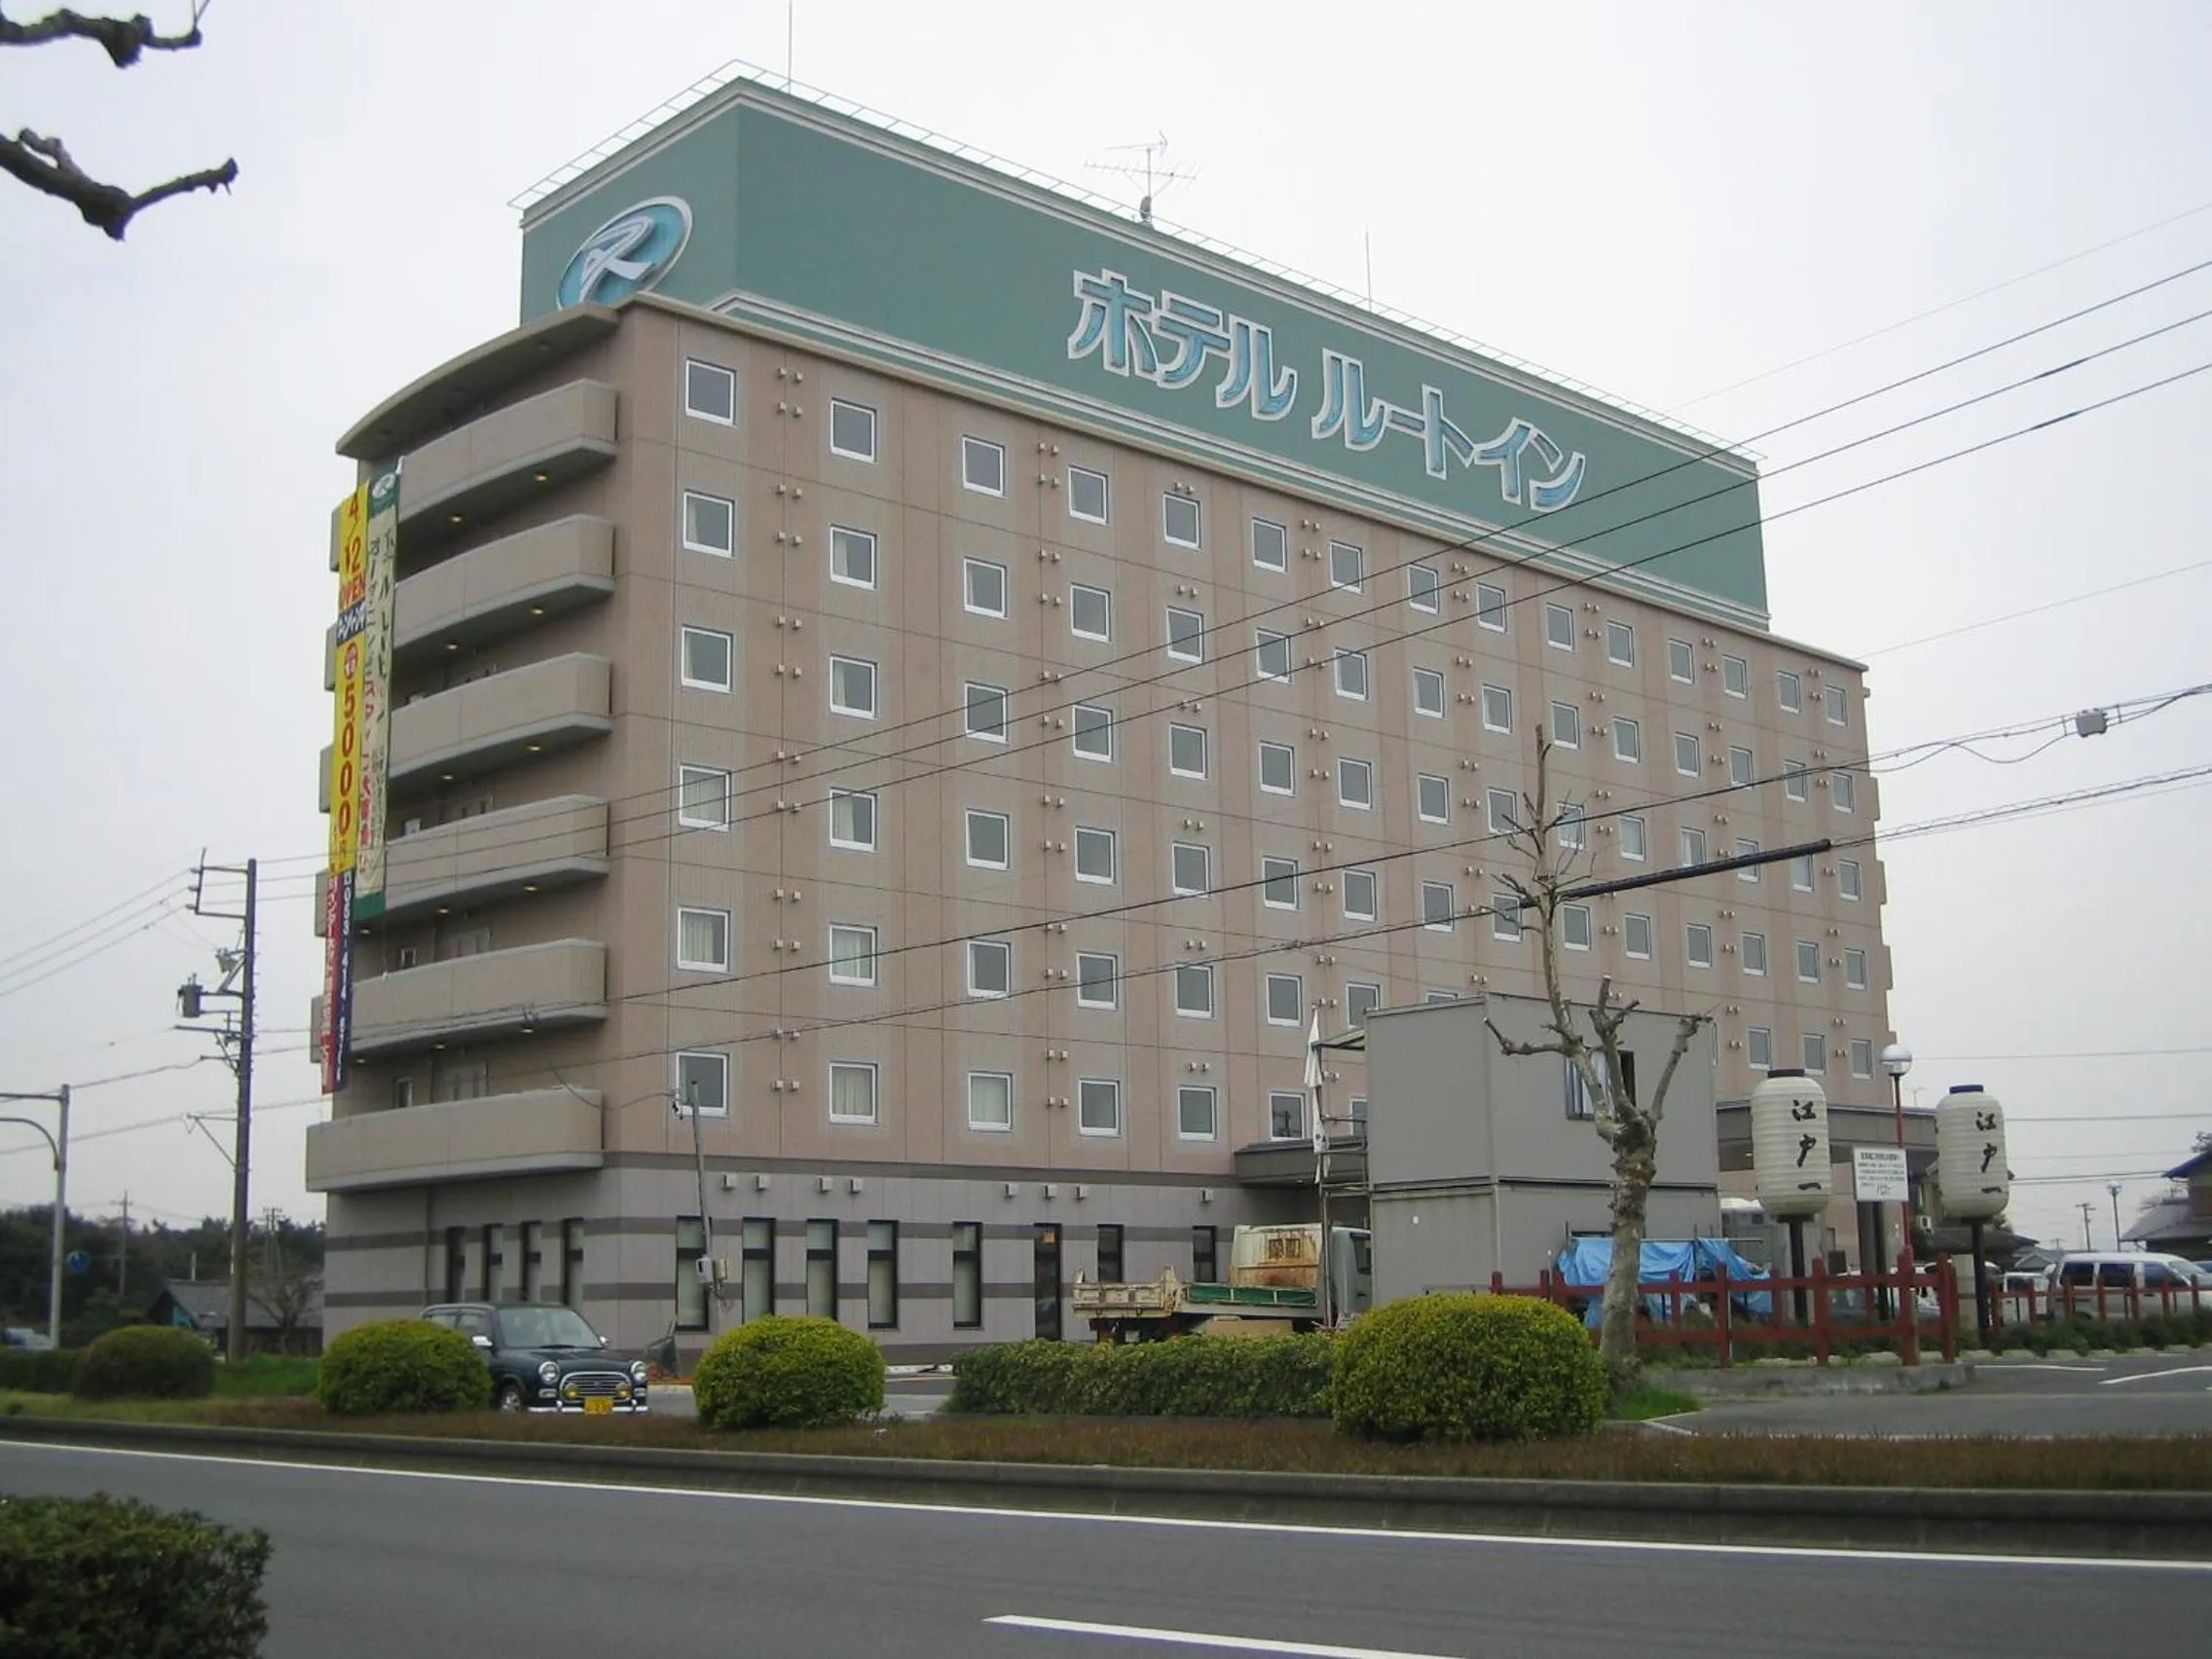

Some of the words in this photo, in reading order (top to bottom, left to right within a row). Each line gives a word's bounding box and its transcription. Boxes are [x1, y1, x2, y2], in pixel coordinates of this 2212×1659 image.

[1068, 268, 1298, 421] ホテル
[1310, 347, 1586, 512] ルートイン
